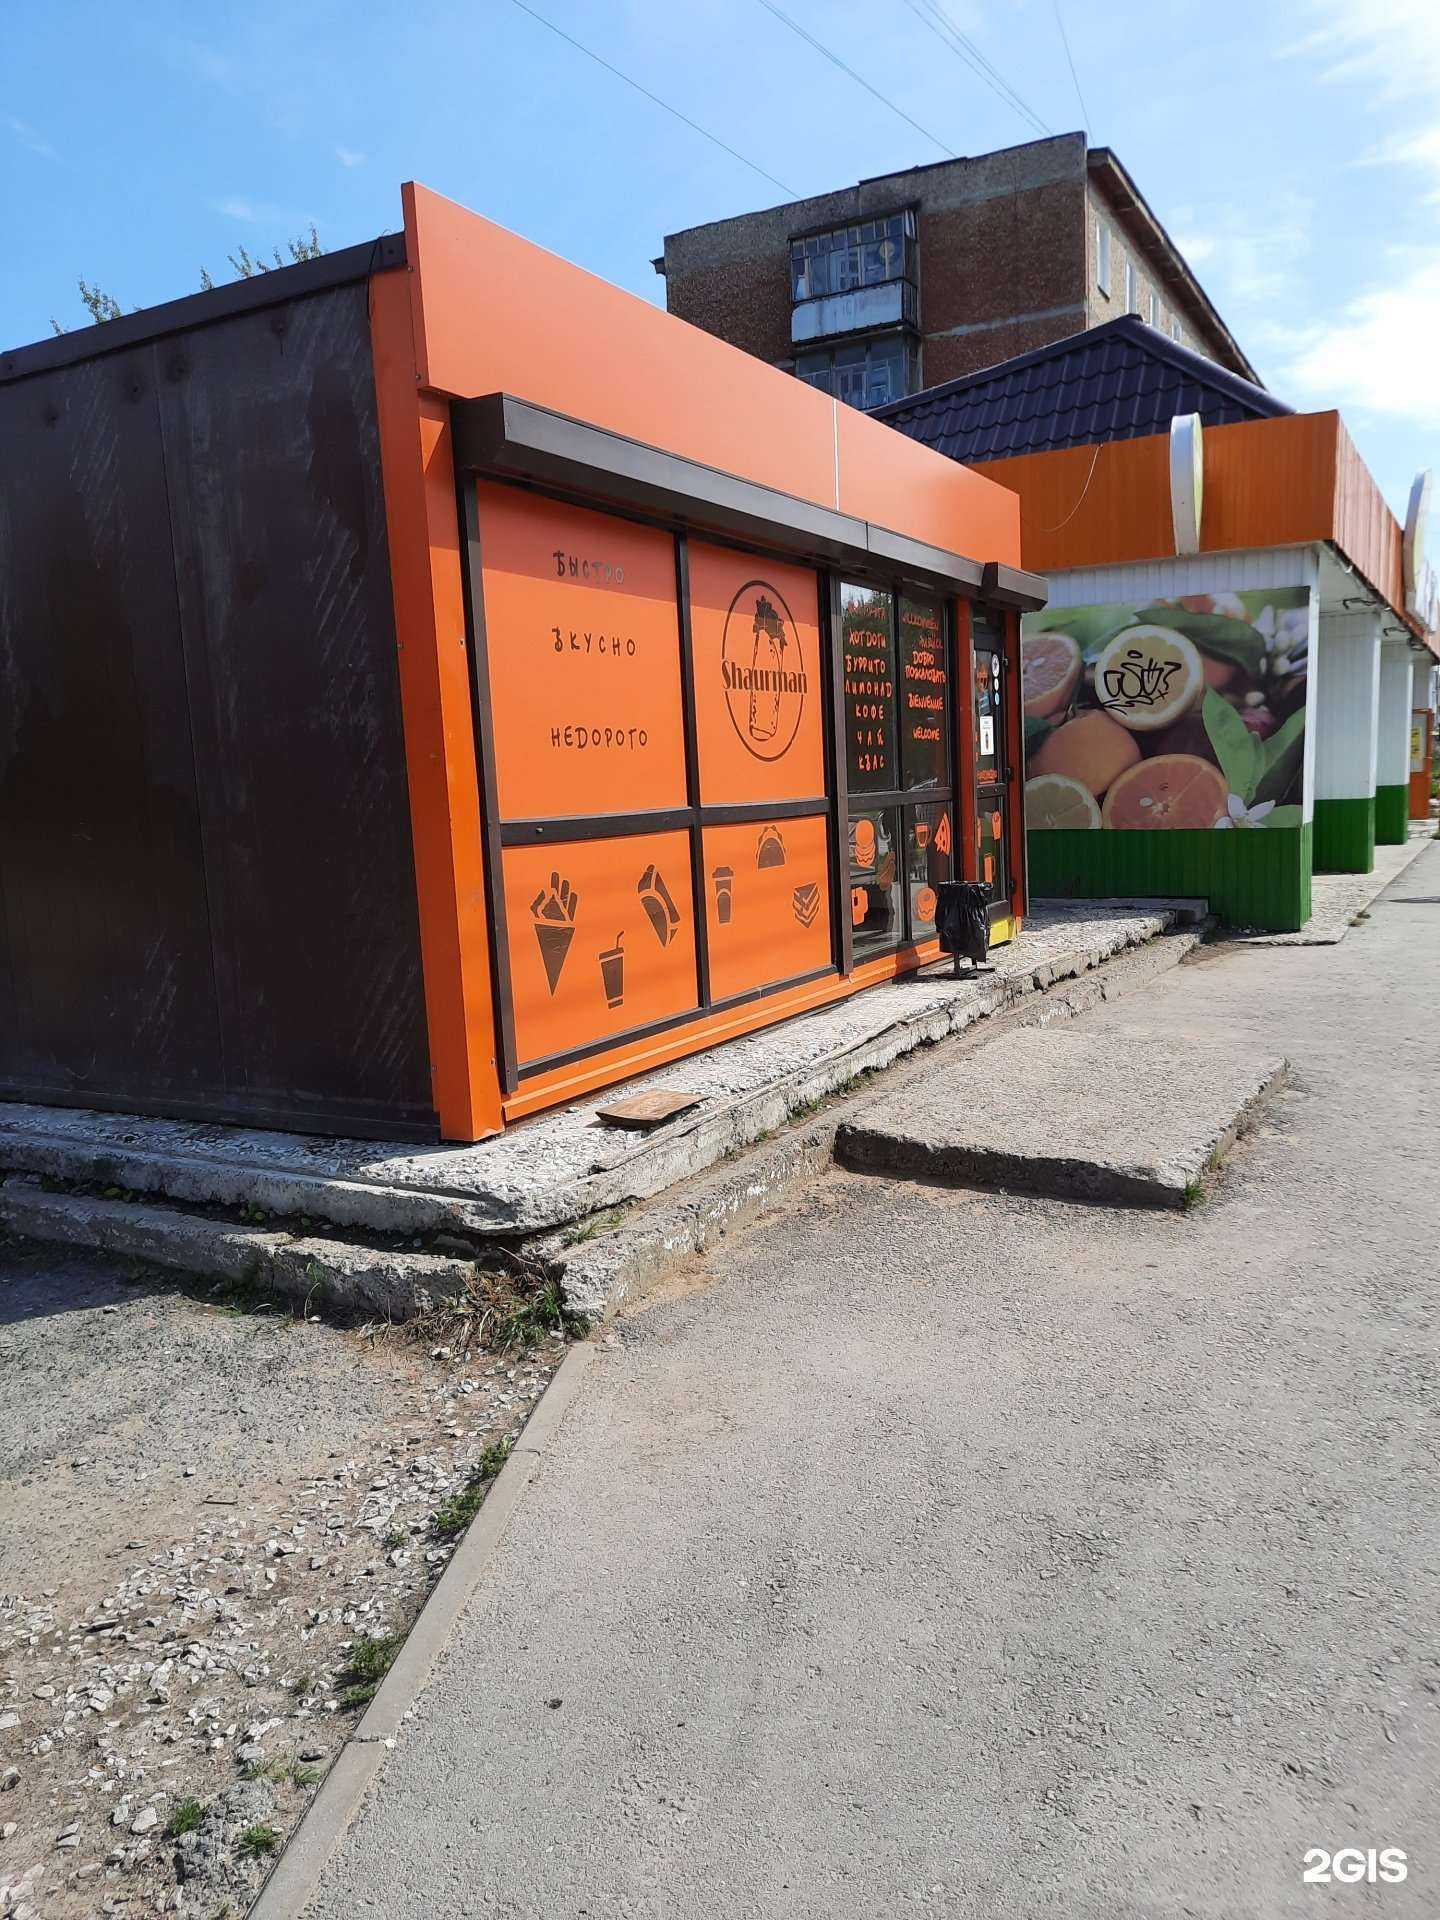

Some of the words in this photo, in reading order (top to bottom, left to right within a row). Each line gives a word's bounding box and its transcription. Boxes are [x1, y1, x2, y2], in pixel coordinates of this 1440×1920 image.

[552, 549, 625, 585] БЫСТРО
[551, 626, 637, 657] ВКУСНО
[845, 654, 887, 675] БУРРИТО
[721, 658, 808, 694] Shaurman
[844, 677, 892, 697] ЛИМОНАД
[855, 703, 883, 720] КОФЕ
[550, 726, 649, 749] НЕДОРОГО
[857, 727, 883, 746] ЧАЙ
[858, 754, 884, 771] КВАС
